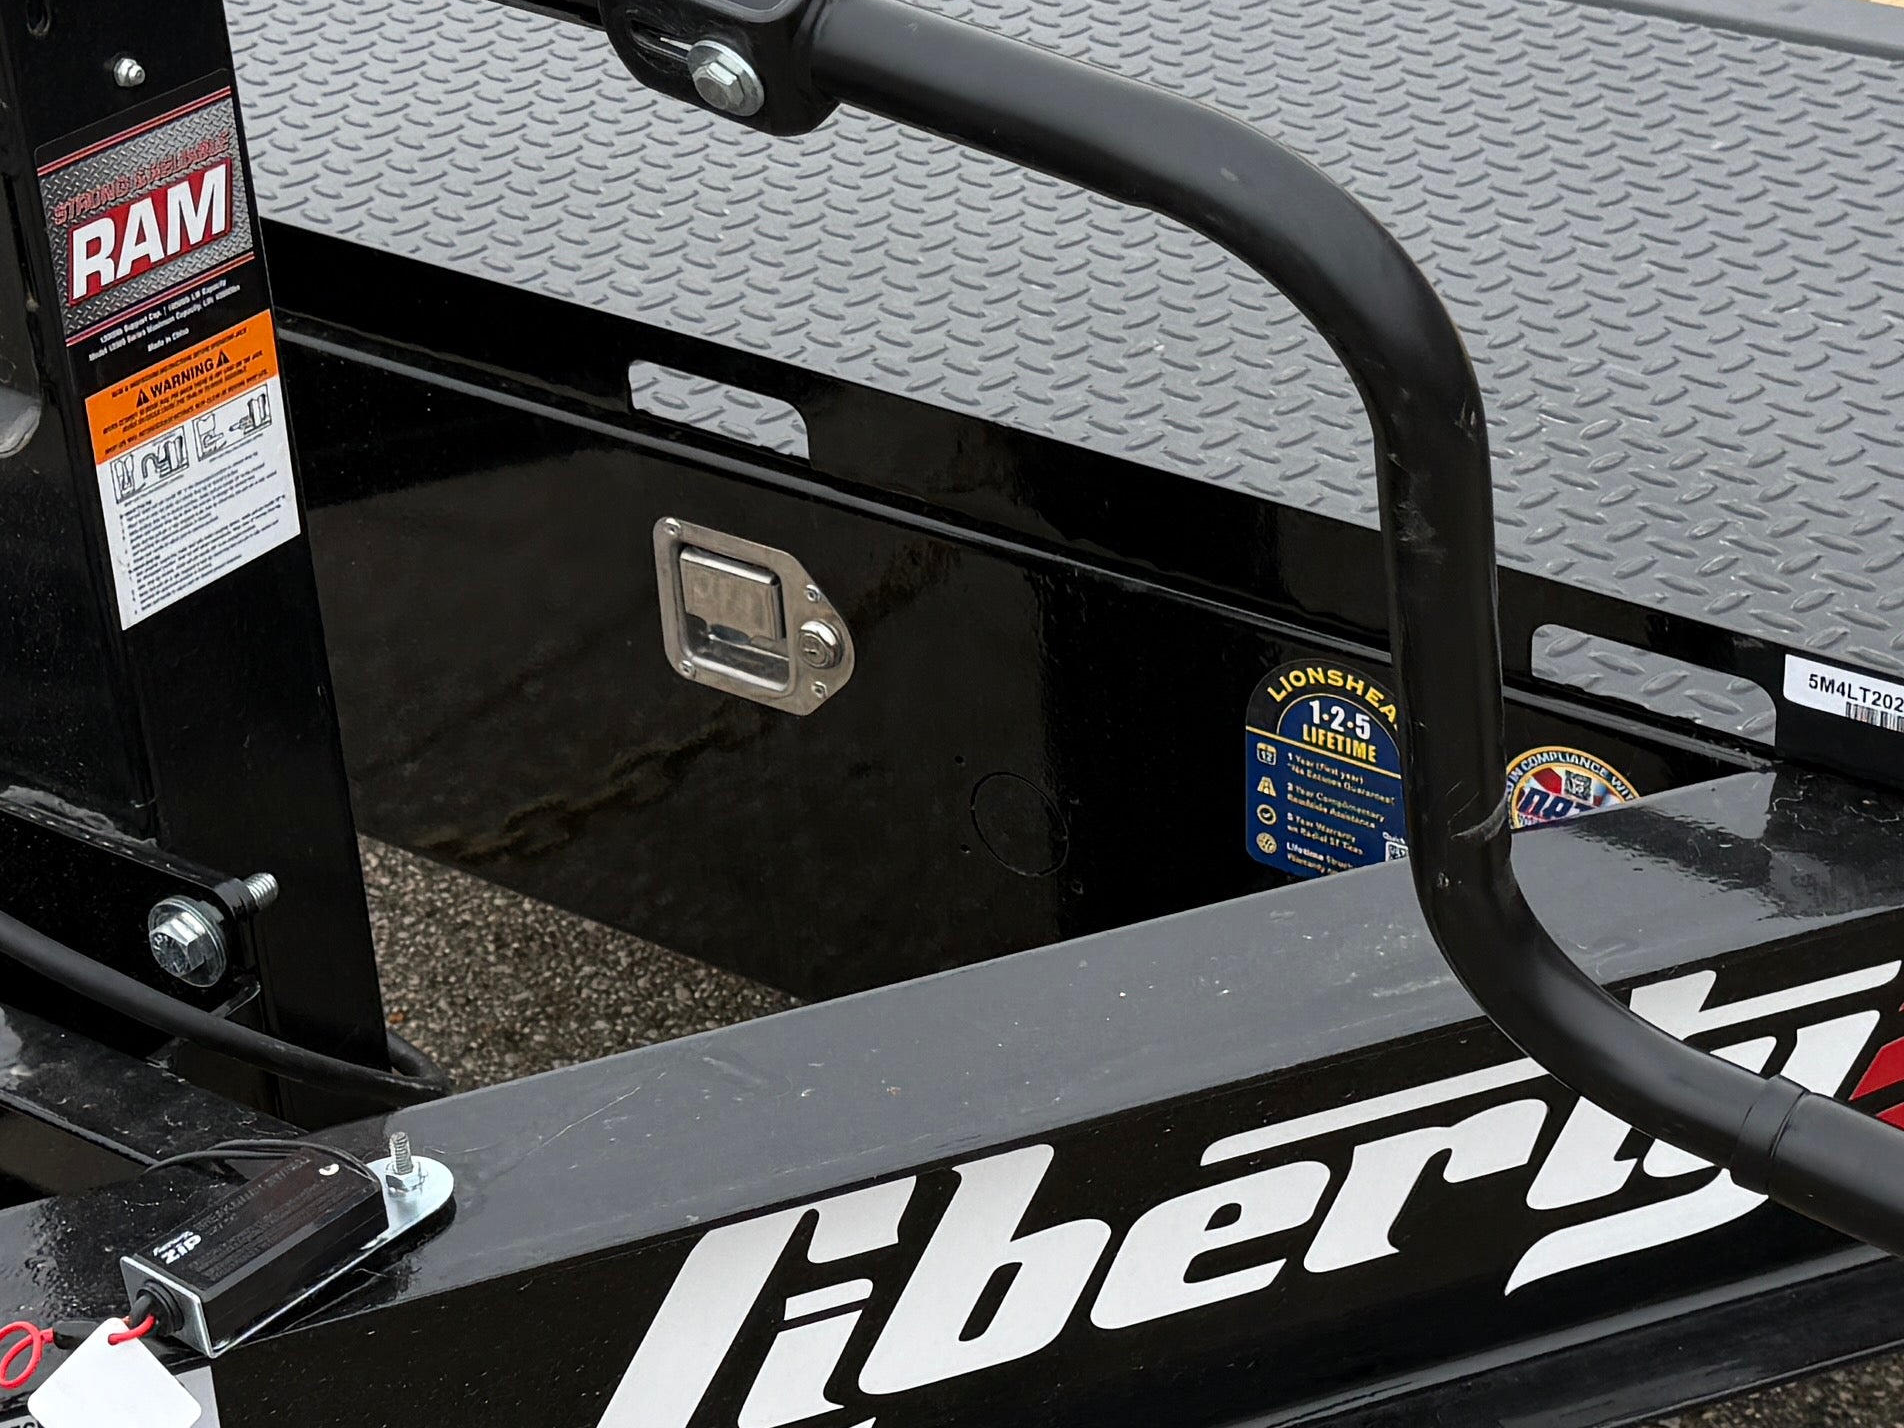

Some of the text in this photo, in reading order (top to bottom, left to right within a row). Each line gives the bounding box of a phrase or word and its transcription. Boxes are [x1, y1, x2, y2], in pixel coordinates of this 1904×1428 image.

[72, 163, 227, 302] RAM
[150, 358, 213, 398] WARNING
[1267, 667, 1398, 732] LIONSHEA
[1302, 724, 1377, 763] LIFETIME
[1521, 752, 1608, 777] COMPLIANCE
